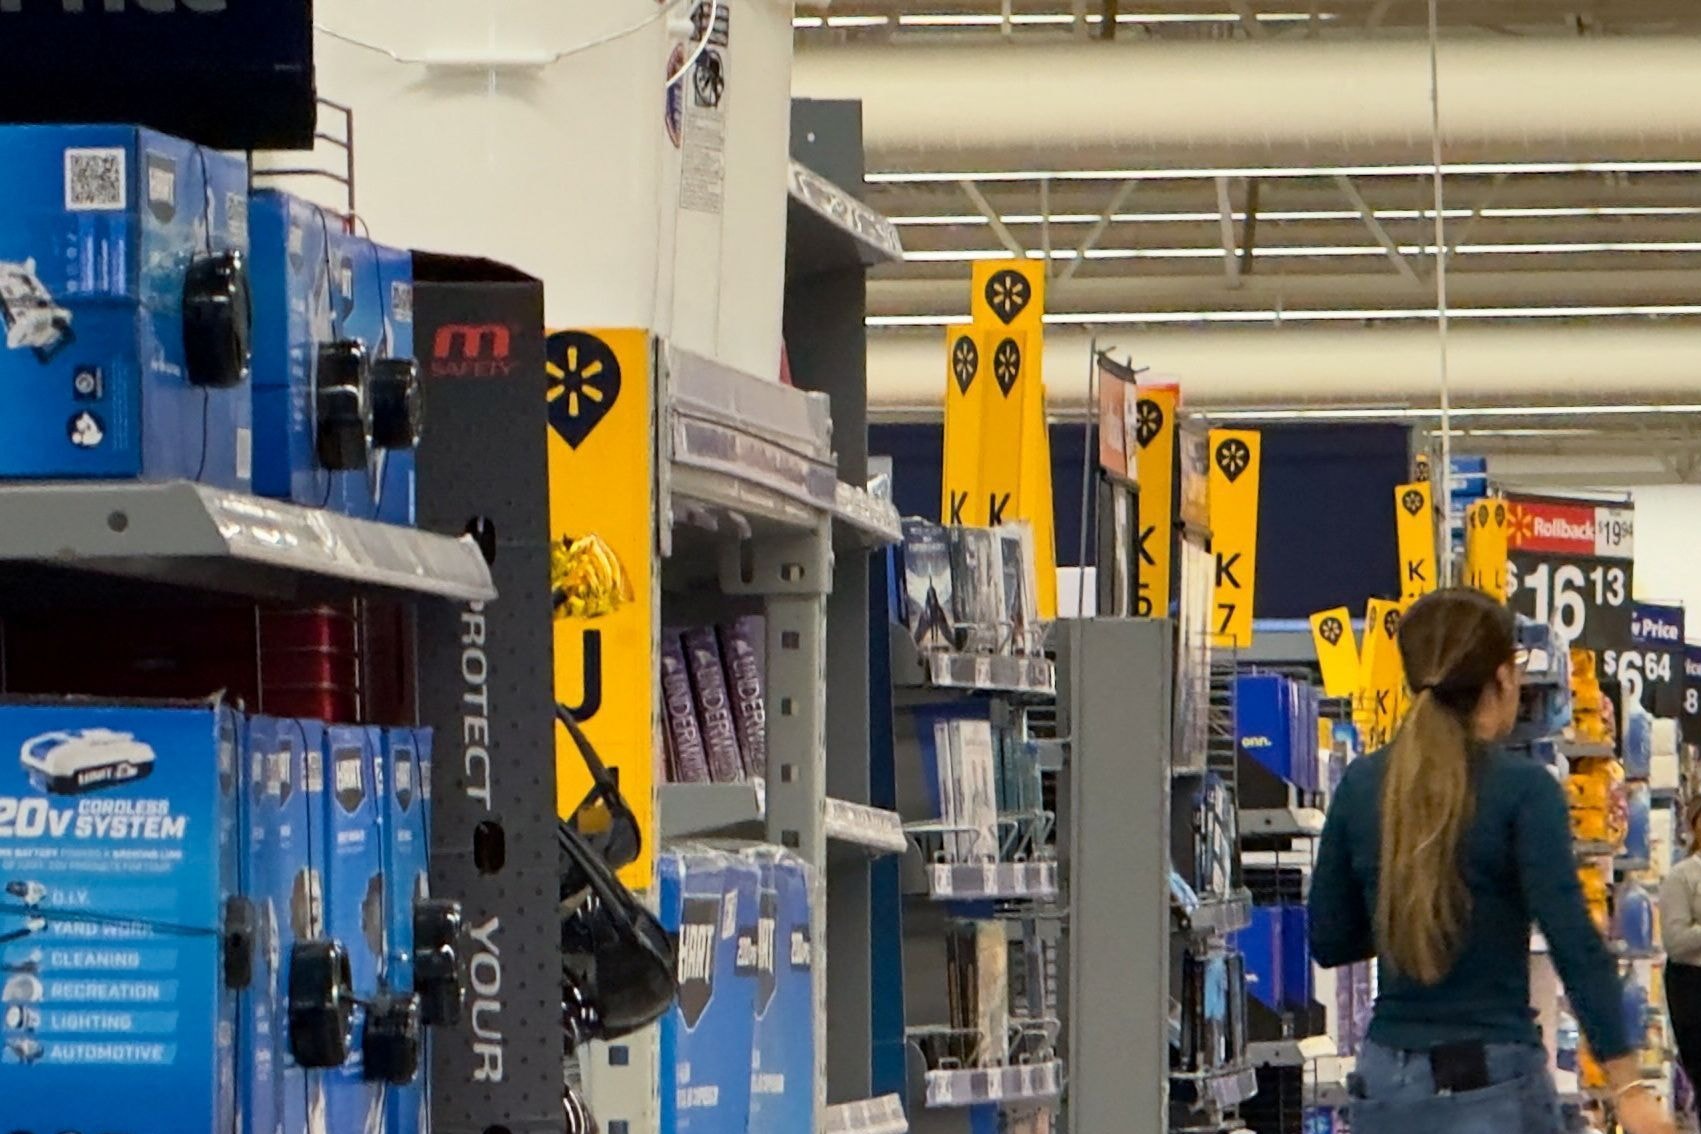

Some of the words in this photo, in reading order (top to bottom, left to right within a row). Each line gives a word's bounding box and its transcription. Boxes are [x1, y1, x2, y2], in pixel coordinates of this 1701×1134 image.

[1534, 517, 1595, 543] Rollback
[1215, 553, 1241, 588] K
[1408, 559, 1426, 582] K
[1217, 604, 1236, 633] 7
[1642, 621, 1679, 641] Price
[78, 798, 171, 815] CORDLESS
[74, 815, 187, 839] SYSTEM
[51, 951, 140, 968] CLEANING
[51, 982, 160, 999] RECREATION
[470, 917, 504, 1083] YOUR
[51, 1014, 132, 1030] LIGHTING
[50, 1044, 164, 1061] AUTOMOTIVE
